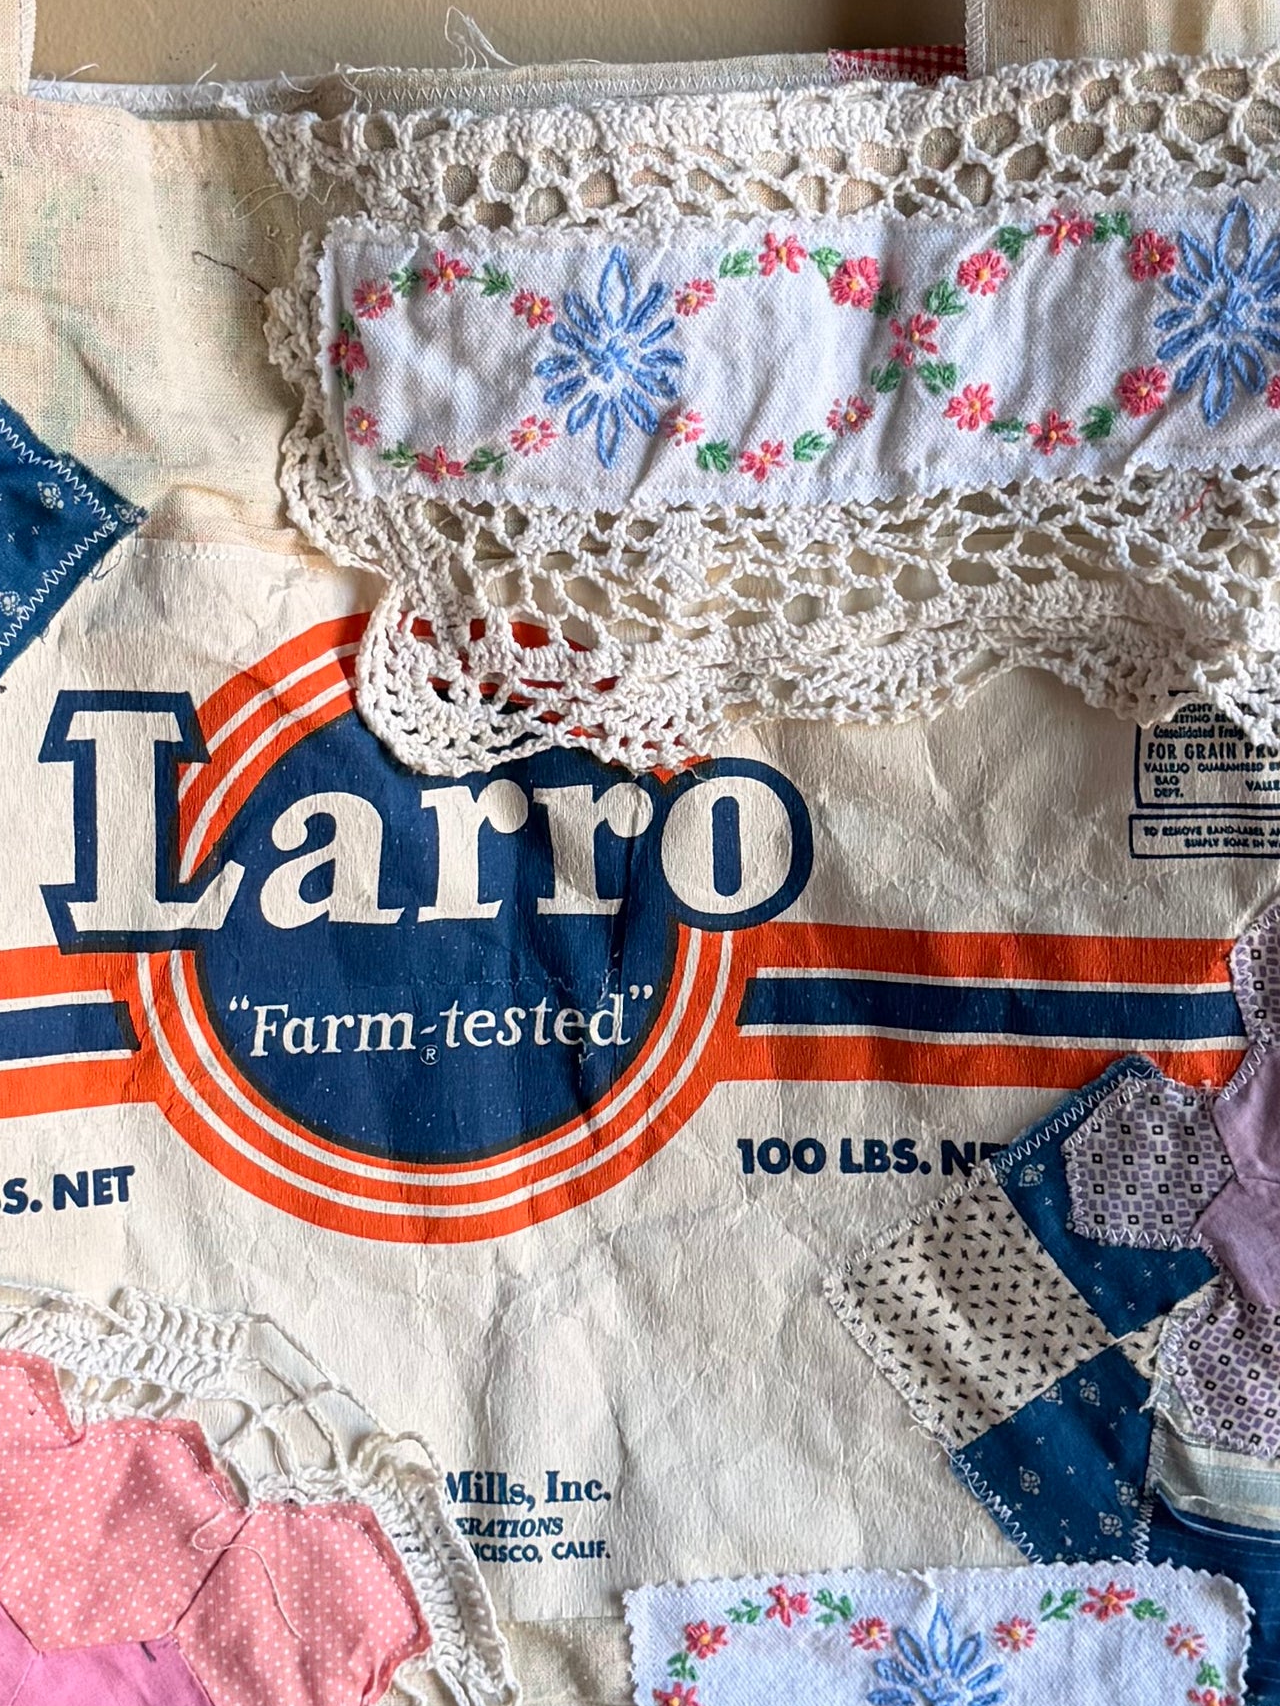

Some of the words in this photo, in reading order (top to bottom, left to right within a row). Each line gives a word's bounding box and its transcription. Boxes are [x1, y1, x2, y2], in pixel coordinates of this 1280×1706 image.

[1171, 714, 1211, 724] EETING
[1153, 724, 1215, 740] Consolidated
[1218, 724, 1246, 741] Freig
[1147, 742, 1177, 760] FOR
[1184, 741, 1237, 760] GRAIN
[1144, 762, 1190, 774] VALLEJO
[1197, 761, 1264, 773] GUARANTEED
[1154, 775, 1180, 786] BAG
[1153, 787, 1184, 798] DEPT.
[40, 691, 811, 951] Larro
[1162, 826, 1202, 836] REMOVE
[737, 1137, 827, 1175] 100
[839, 1137, 933, 1175] LBS.
[52, 1165, 136, 1211] NET
[445, 1470, 537, 1513] Mills,
[545, 1470, 612, 1503] Inc.
[455, 1516, 564, 1539] ERATIONS
[469, 1541, 543, 1564] NCISCO,
[551, 1540, 612, 1561] CALIF.
